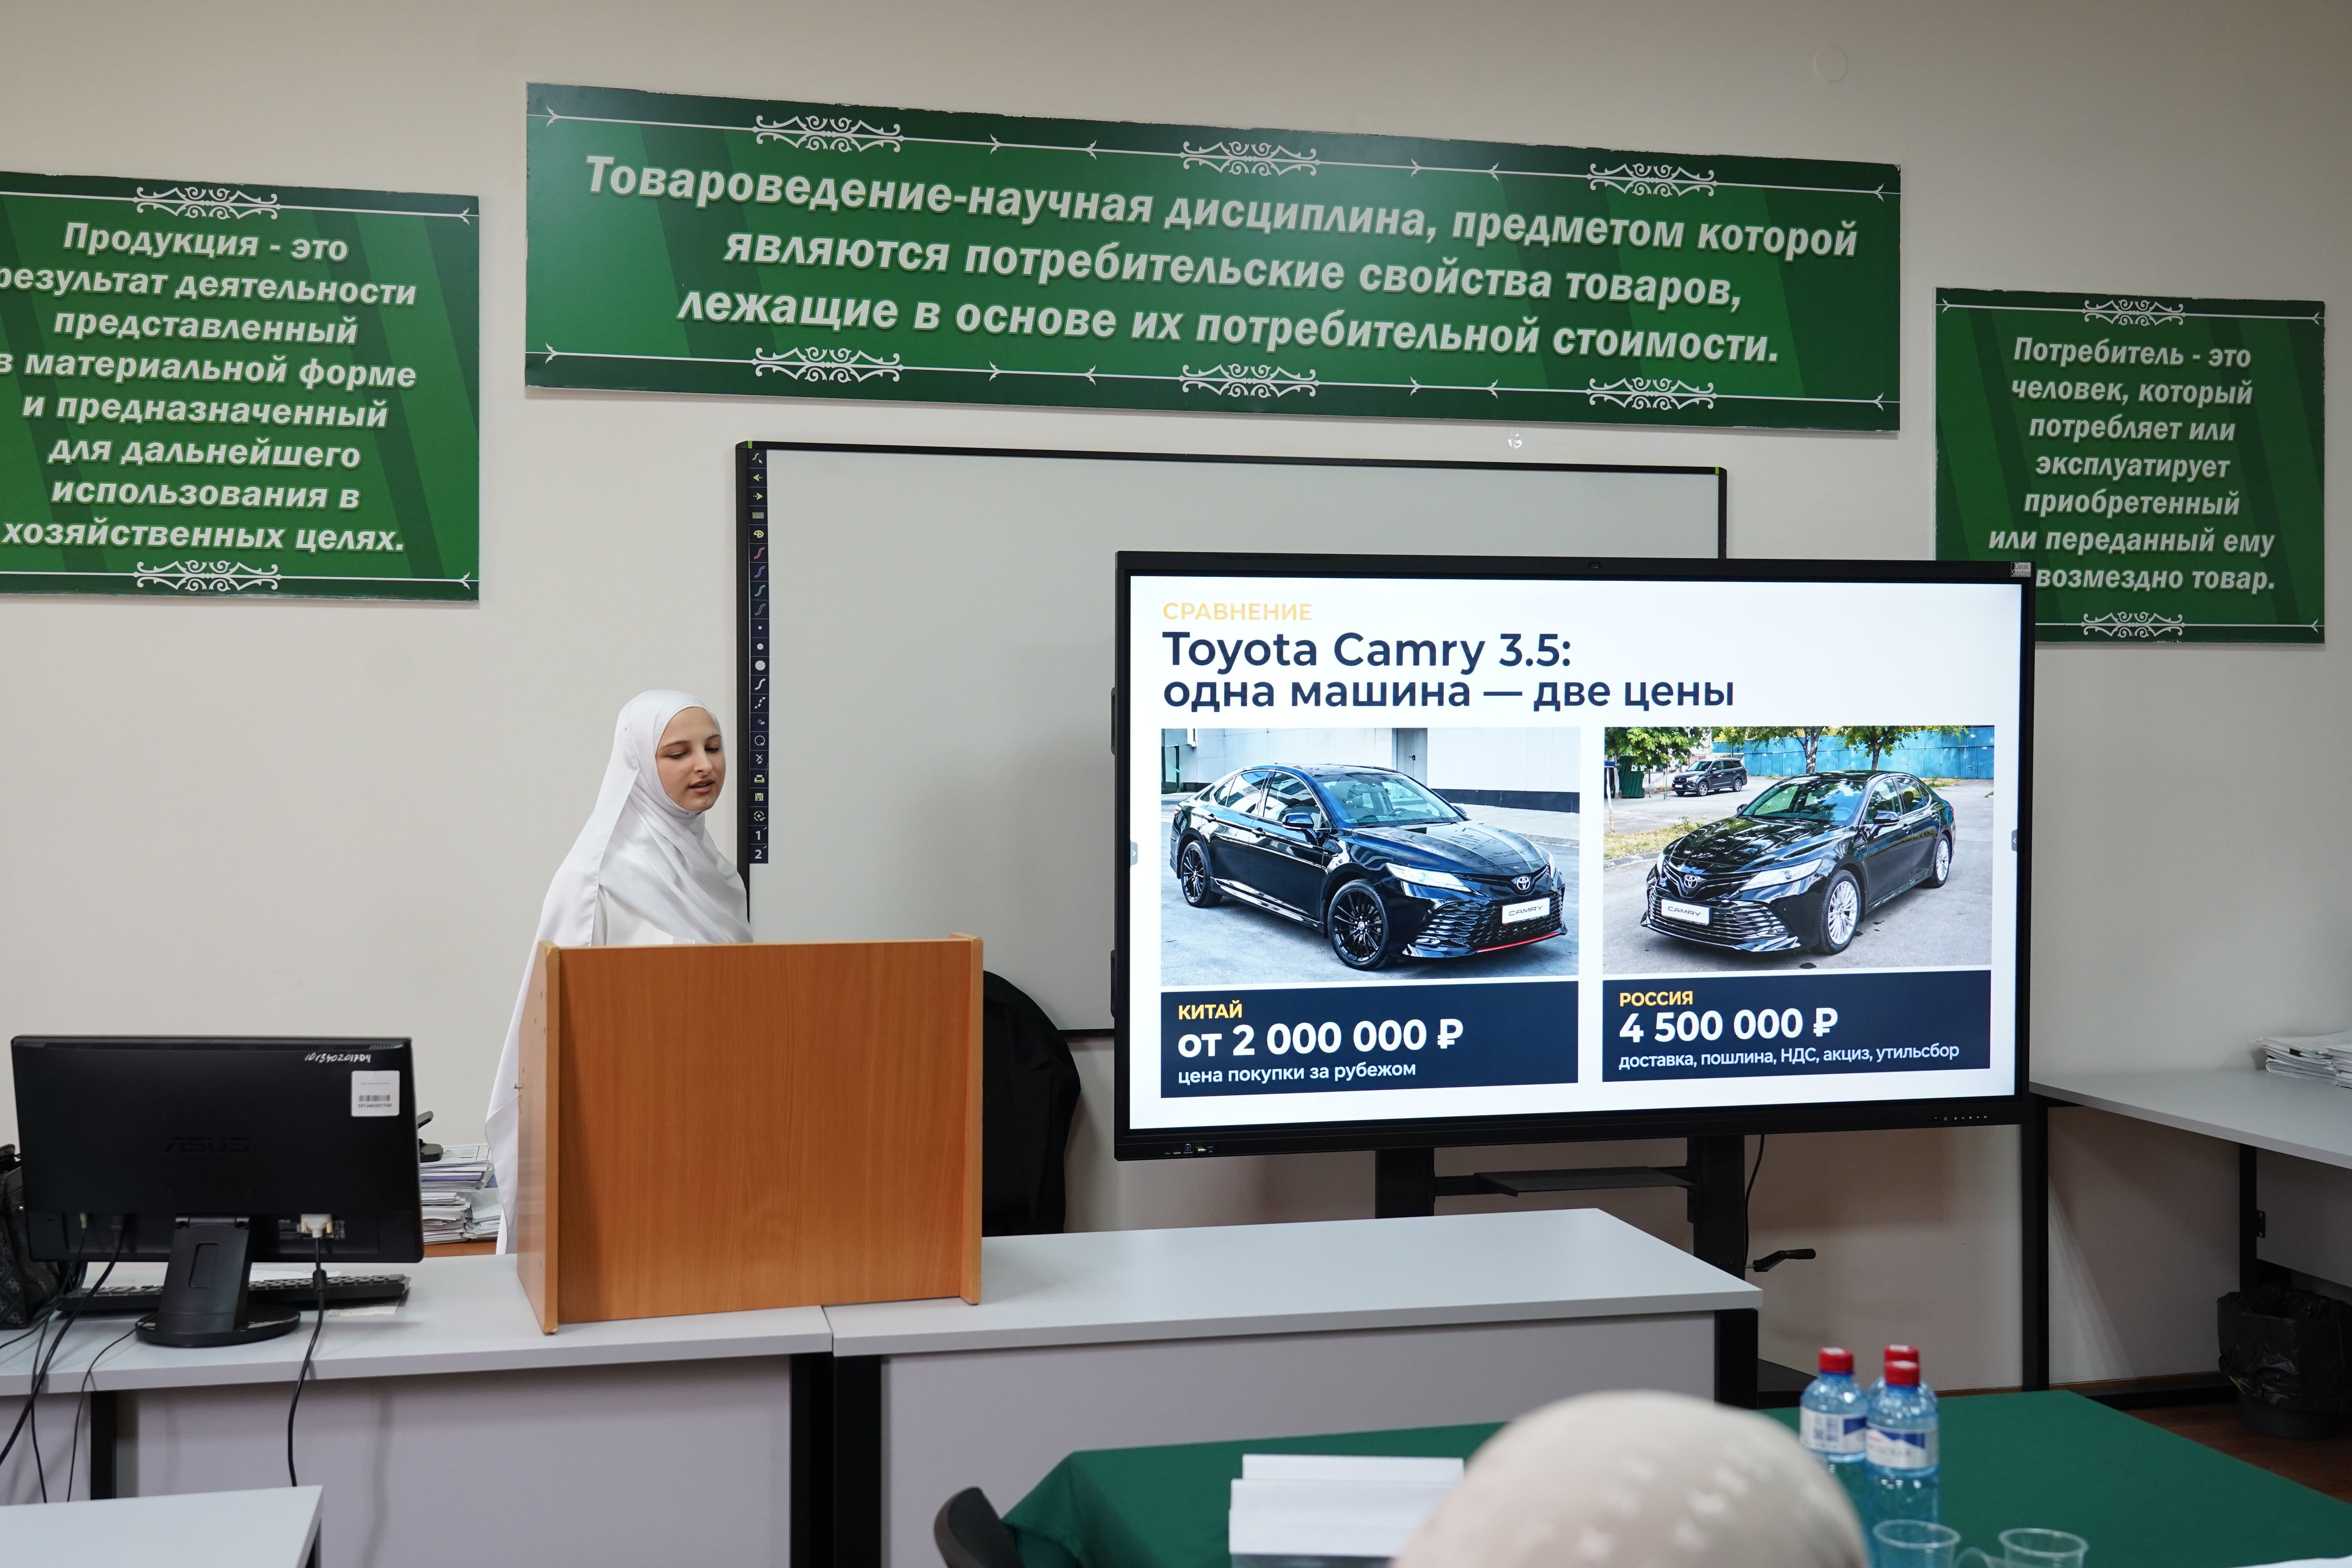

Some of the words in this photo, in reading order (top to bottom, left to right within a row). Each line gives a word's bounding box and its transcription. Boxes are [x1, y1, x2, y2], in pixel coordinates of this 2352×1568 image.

[586, 155, 1153, 224] Товароведение-научная
[1164, 198, 1436, 243] дисциплина,
[1452, 212, 1684, 247] предметом
[1698, 221, 1857, 261] которой
[64, 222, 259, 258] Продукция
[291, 239, 347, 260] это
[724, 234, 949, 270] являются
[965, 242, 1344, 289] потребительские
[1359, 257, 1551, 297] свойства
[1566, 273, 1740, 312] товаров,
[174, 276, 416, 305] деятельности
[54, 313, 357, 343] представленный
[677, 292, 898, 331] лежащие
[914, 302, 940, 329] в
[956, 304, 1116, 337] основе
[1132, 312, 1183, 339] их
[1196, 309, 1539, 352] потребительной
[1553, 328, 1777, 361] стоимости.
[2014, 337, 2183, 367] Потребитель
[2209, 348, 2251, 367] это
[0, 353, 13, 373] в
[25, 354, 287, 383] материальной
[299, 358, 416, 390] форме
[2012, 380, 2128, 405] человек,
[2139, 380, 2252, 408] который
[23, 397, 45, 416] и
[57, 397, 387, 427] предназначенный
[2029, 414, 2182, 443] потребляет
[2189, 423, 2235, 441] или
[48, 440, 112, 463] для
[120, 437, 360, 467] дальнейшего
[2036, 456, 2230, 482] эксплуатирует
[52, 482, 328, 507] использования
[339, 489, 359, 508] в
[2024, 488, 2239, 518] приобретенный
[2, 517, 285, 548] хозяйственных
[296, 530, 403, 552] целях.
[1989, 531, 2037, 549] или
[2046, 527, 2215, 555] переданный
[2224, 534, 2275, 557] ему
[2192, 571, 2274, 594] товар.
[1163, 602, 1312, 621] СРАВНЕНИЕ
[1162, 632, 1317, 675] Toyota
[1334, 632, 1486, 675] Camry
[1499, 633, 1570, 667] 3.5:
[1164, 681, 1274, 712] одна
[1292, 682, 1470, 707] машина
[1534, 682, 1610, 712] две
[1625, 682, 1733, 711] цены
[755, 830, 761, 840] 1
[755, 849, 762, 859] 2
[1509, 905, 1543, 916] CAMRY
[1668, 906, 1701, 916] CAMRY
[1179, 1000, 1242, 1020] КИТАЙ
[1620, 991, 1693, 1007] РОССИЯ
[1178, 1033, 1222, 1058] от
[1232, 1024, 1255, 1056] 2
[1267, 1022, 1341, 1055] 000
[1353, 1019, 1426, 1052] 000
[1437, 1018, 1463, 1049] ₽
[1619, 1013, 1644, 1043] 4
[1654, 1010, 1723, 1042] 500
[1733, 1008, 1803, 1040] 000
[1813, 1007, 1838, 1037] ₽
[1619, 1054, 1697, 1070] доставка,
[1701, 1052, 1777, 1065] пошлина,
[1781, 1047, 1819, 1064] НДС,
[1823, 1049, 1873, 1062] акциз,
[1876, 1043, 1959, 1062] утильсбор
[1178, 1071, 1222, 1085] цена
[1229, 1068, 1304, 1084] покупки
[1310, 1067, 1329, 1079] за
[1335, 1062, 1416, 1082] рубежом
[165, 1137, 251, 1152] ASUS
